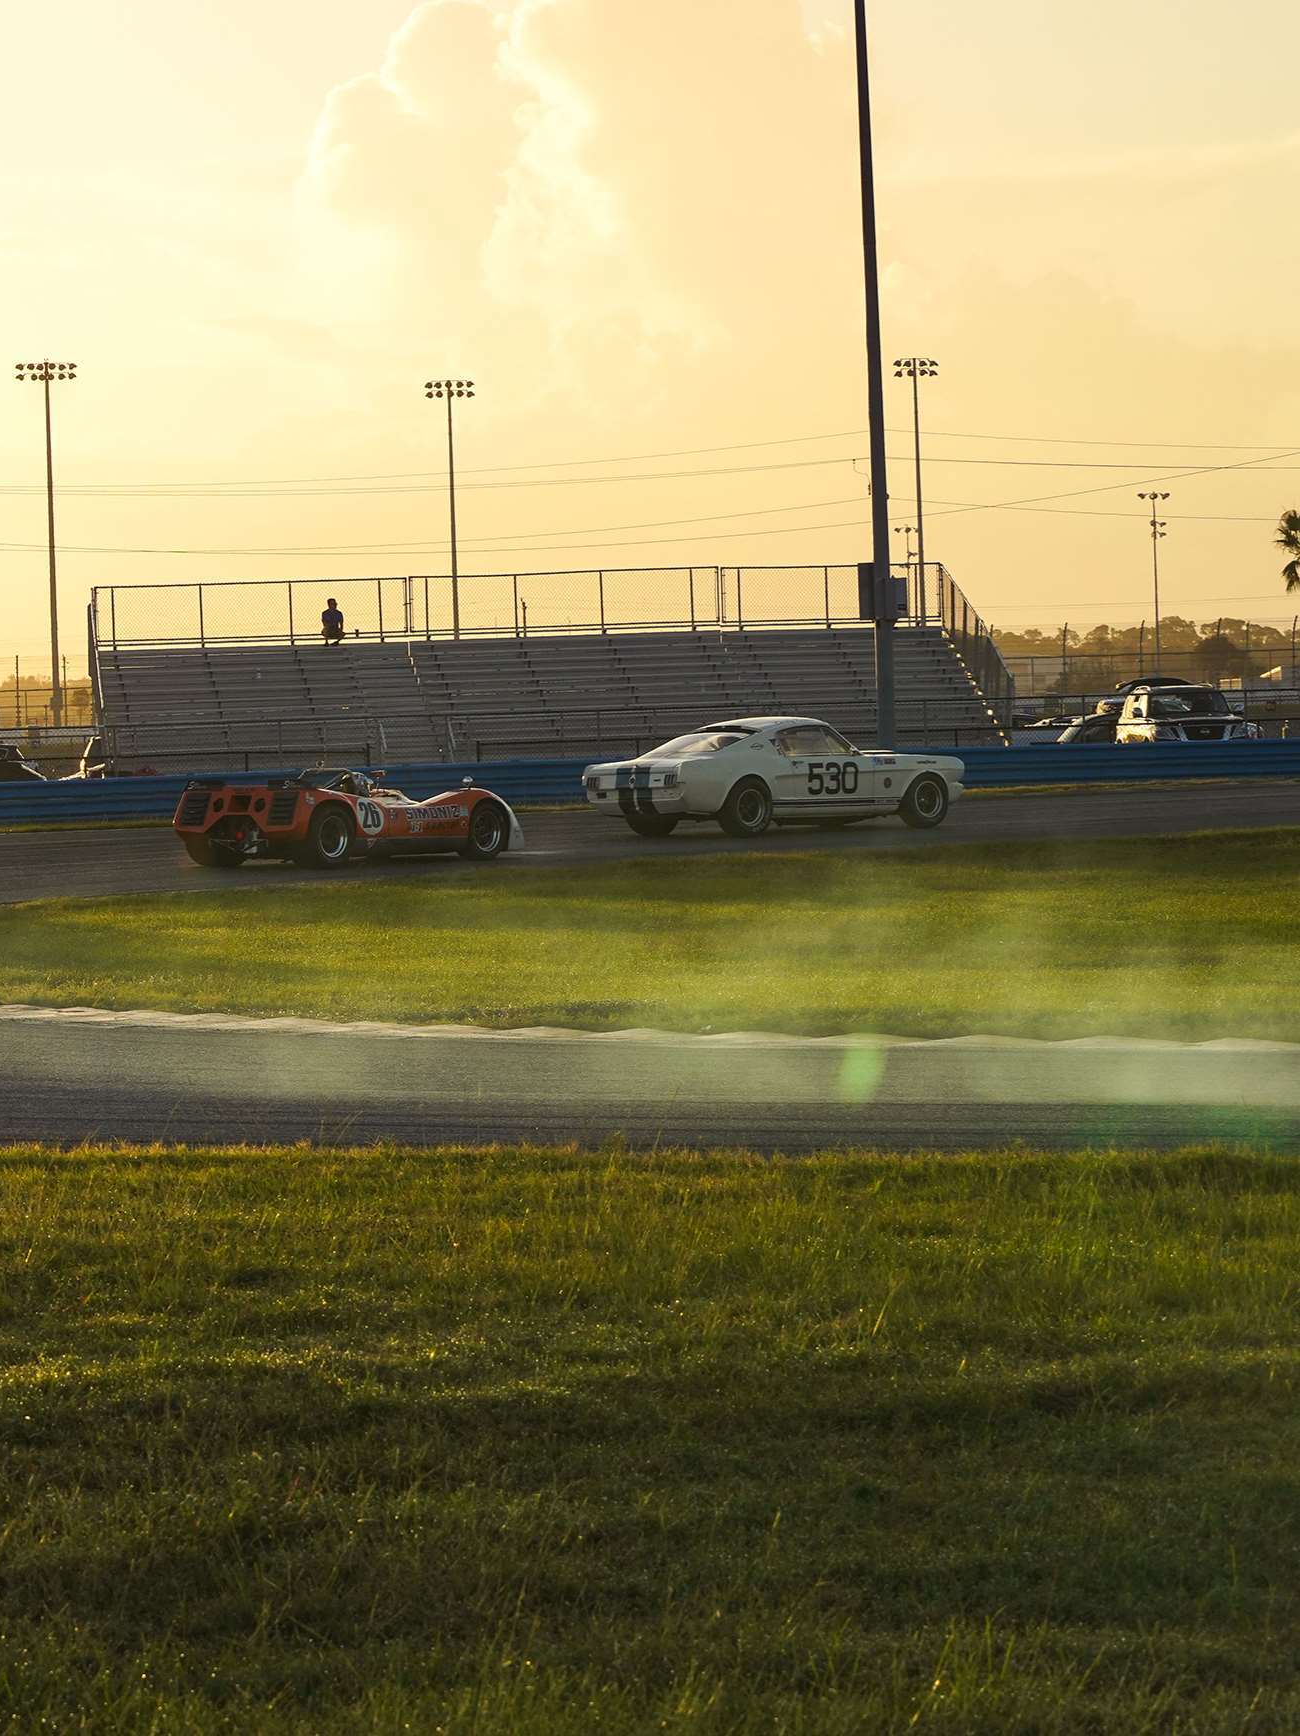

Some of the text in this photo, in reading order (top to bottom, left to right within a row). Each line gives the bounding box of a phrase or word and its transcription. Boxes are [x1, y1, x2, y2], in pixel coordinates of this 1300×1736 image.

[807, 761, 859, 795] 530
[358, 800, 382, 829] 26
[405, 804, 461, 821] SIMONIZ
